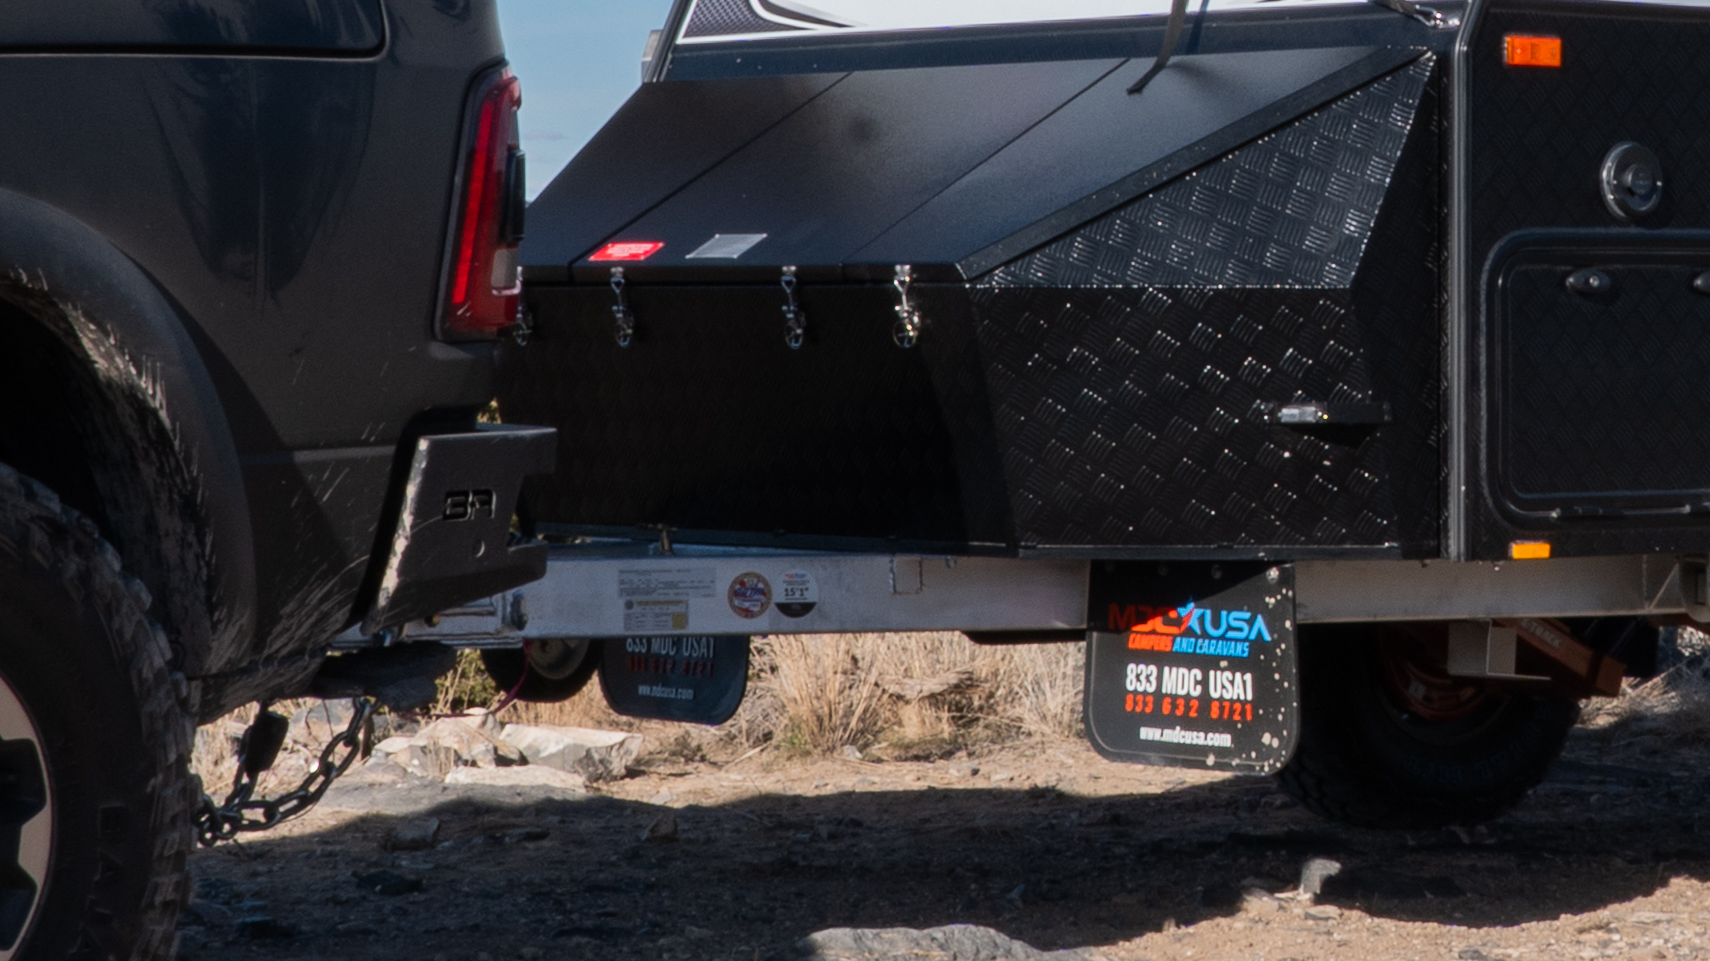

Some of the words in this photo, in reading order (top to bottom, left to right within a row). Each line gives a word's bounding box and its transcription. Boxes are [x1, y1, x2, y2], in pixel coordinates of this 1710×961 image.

[1172, 637, 1196, 654] AND
[1195, 638, 1250, 658] CARAVANS
[1125, 662, 1158, 694] 833
[1161, 665, 1203, 698] MDC
[1208, 669, 1254, 702] USA1
[1125, 694, 1154, 714] 833
[1161, 696, 1199, 718] 632
[1210, 700, 1253, 722] 8721
[1139, 725, 1232, 749] www.mdcusa.com
